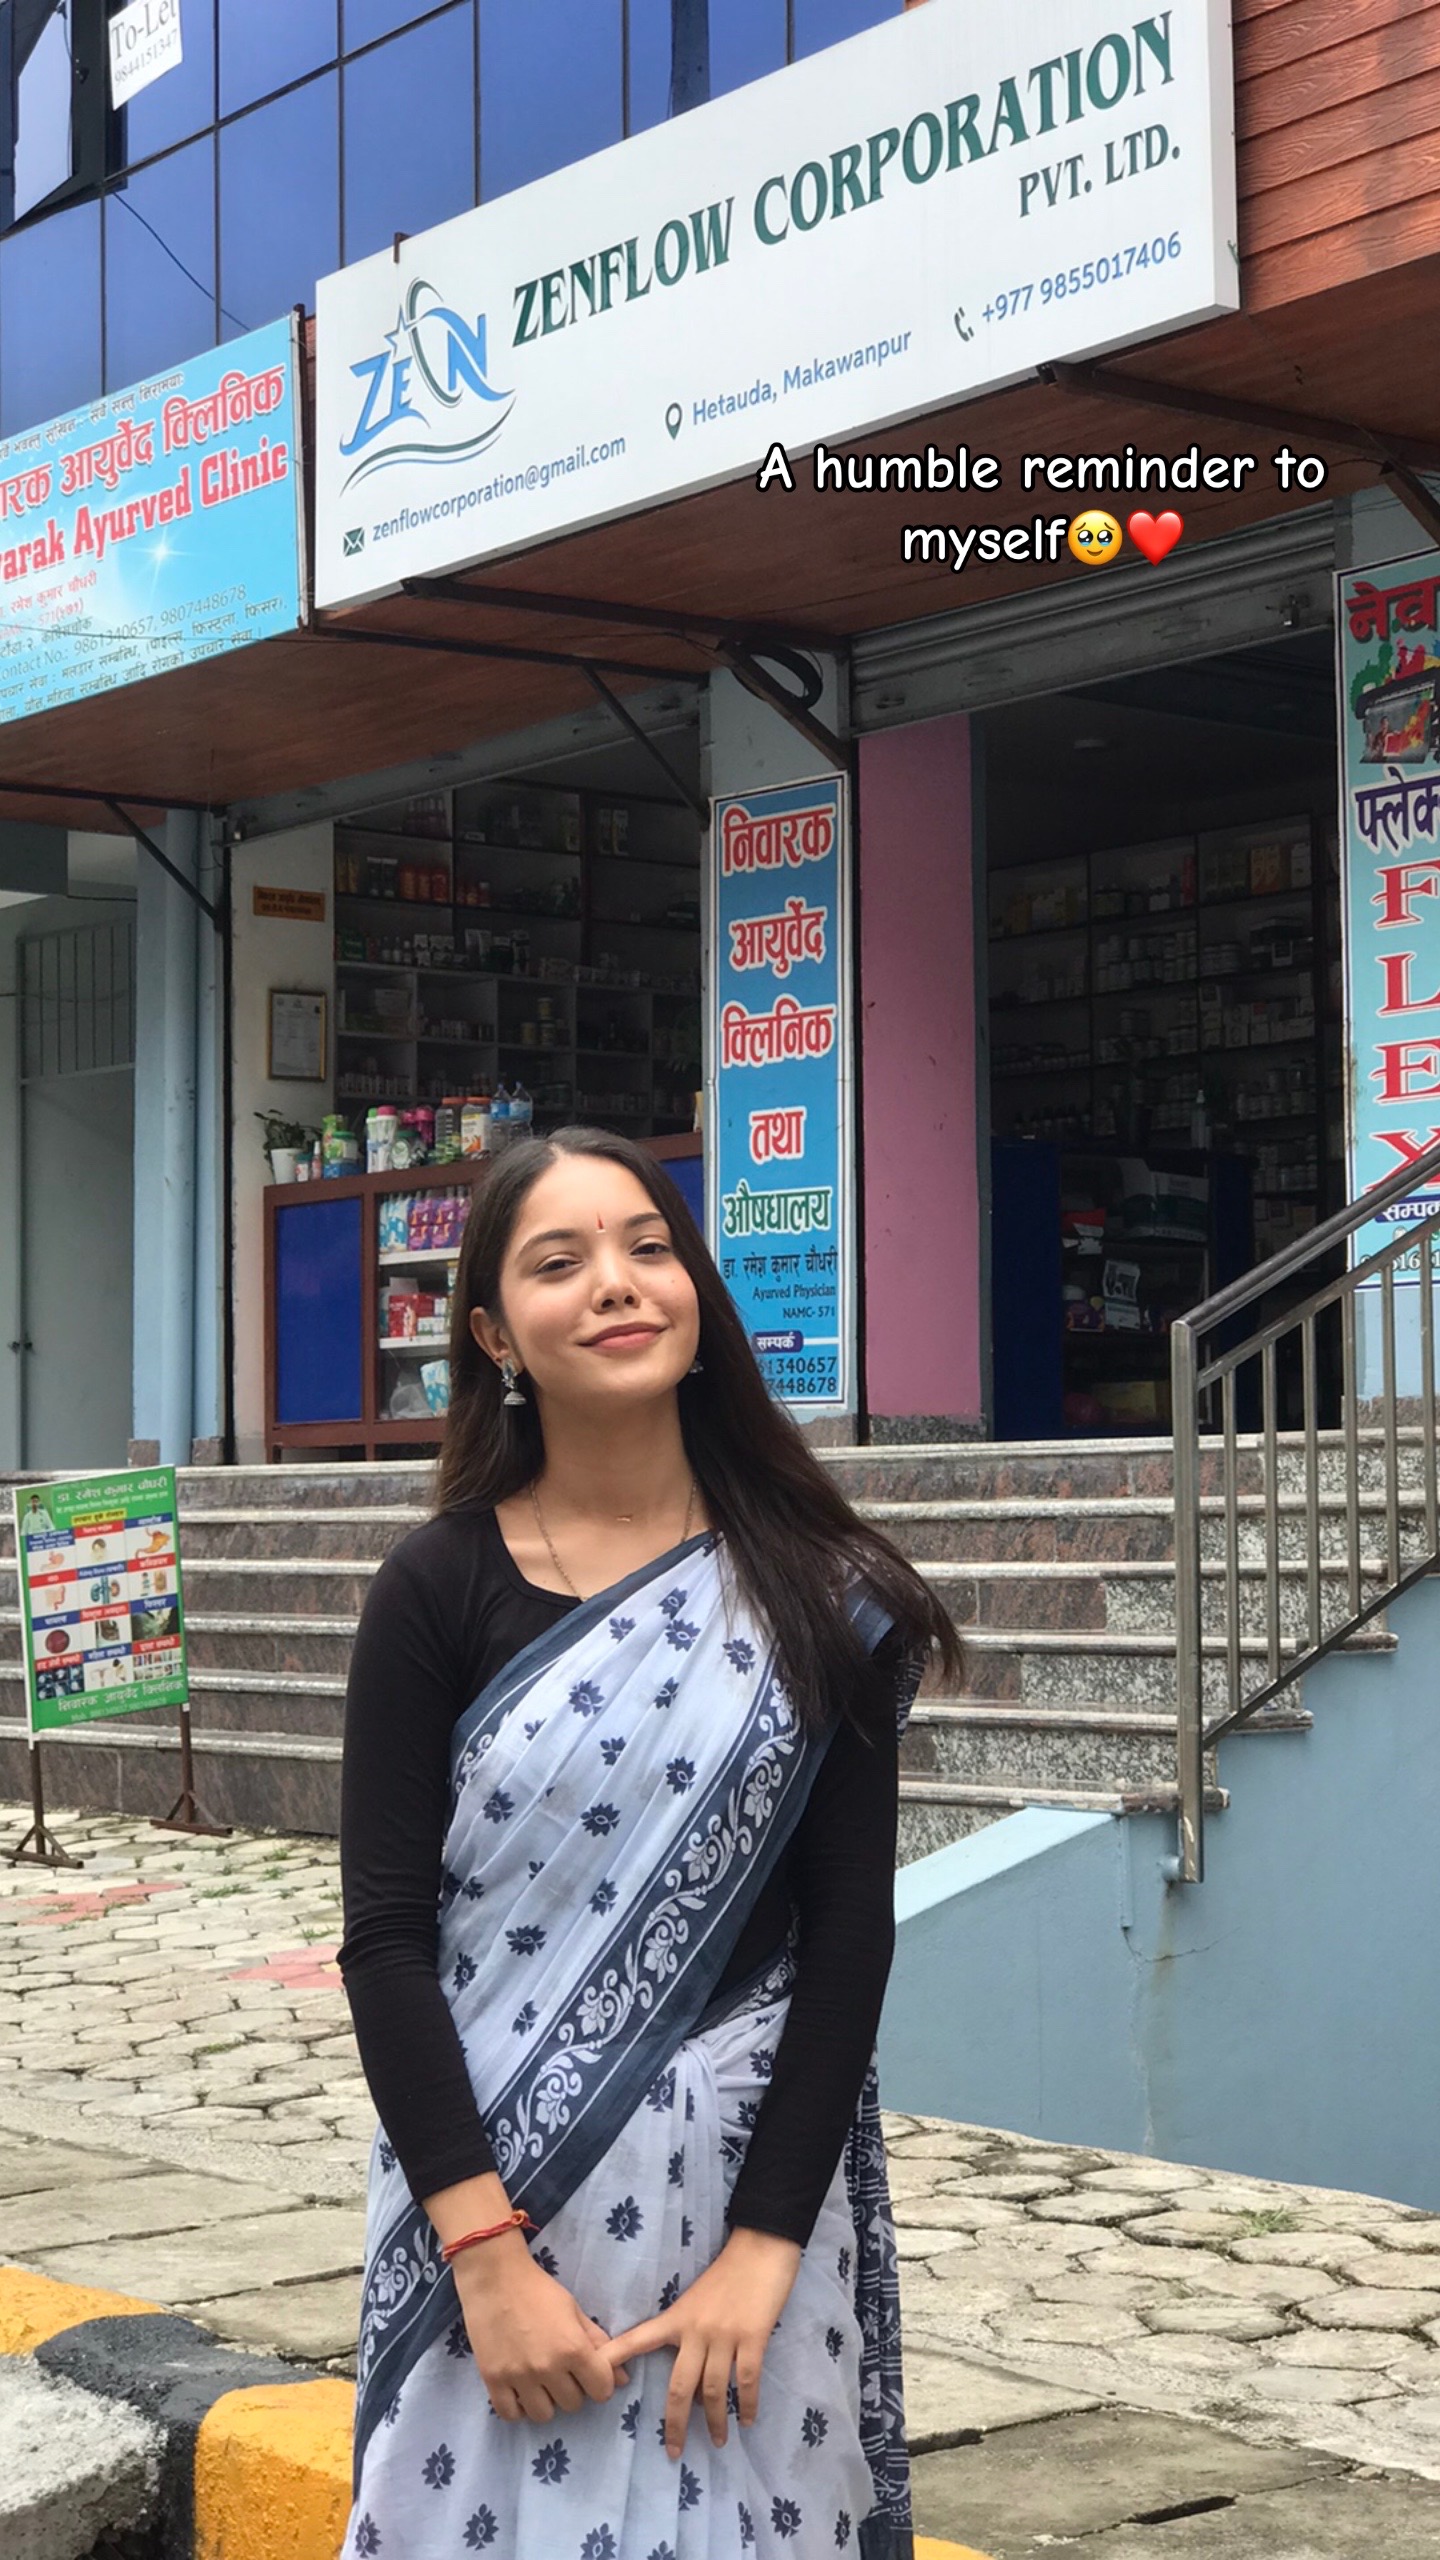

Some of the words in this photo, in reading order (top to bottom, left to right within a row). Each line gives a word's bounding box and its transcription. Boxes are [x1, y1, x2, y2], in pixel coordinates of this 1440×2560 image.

[111, 0, 177, 59] To-Let
[512, 195, 735, 348] ZENFLOW
[752, 10, 1175, 247] CORPORATION
[1018, 154, 1092, 219] PVT.
[1104, 122, 1180, 187] LTD.
[981, 285, 1033, 325] +977
[1039, 231, 1182, 307] 9855017406
[691, 380, 779, 428] Hetauda,
[782, 327, 912, 394] Makawanpur
[60, 419, 154, 490] आयुर्वेद
[163, 366, 285, 453] क्लिनिक
[0, 518, 65, 582] arak
[74, 466, 192, 559] Ayurved
[201, 437, 287, 506] Clinic
[372, 436, 627, 542] zenflowcorporation@gmail.com
[160, 584, 246, 627] 9807448678
[722, 806, 834, 872] निवारक
[731, 900, 825, 975] आयुर्वेद
[723, 997, 834, 1064] क्लिनिक
[752, 1111, 804, 1160] तथा
[724, 1181, 831, 1234] औषधालय
[752, 1286, 791, 1302] Ayurved
[793, 1283, 836, 1300] Physician
[818, 1305, 836, 1317] 571
[756, 1332, 796, 1351] सम्पर्क
